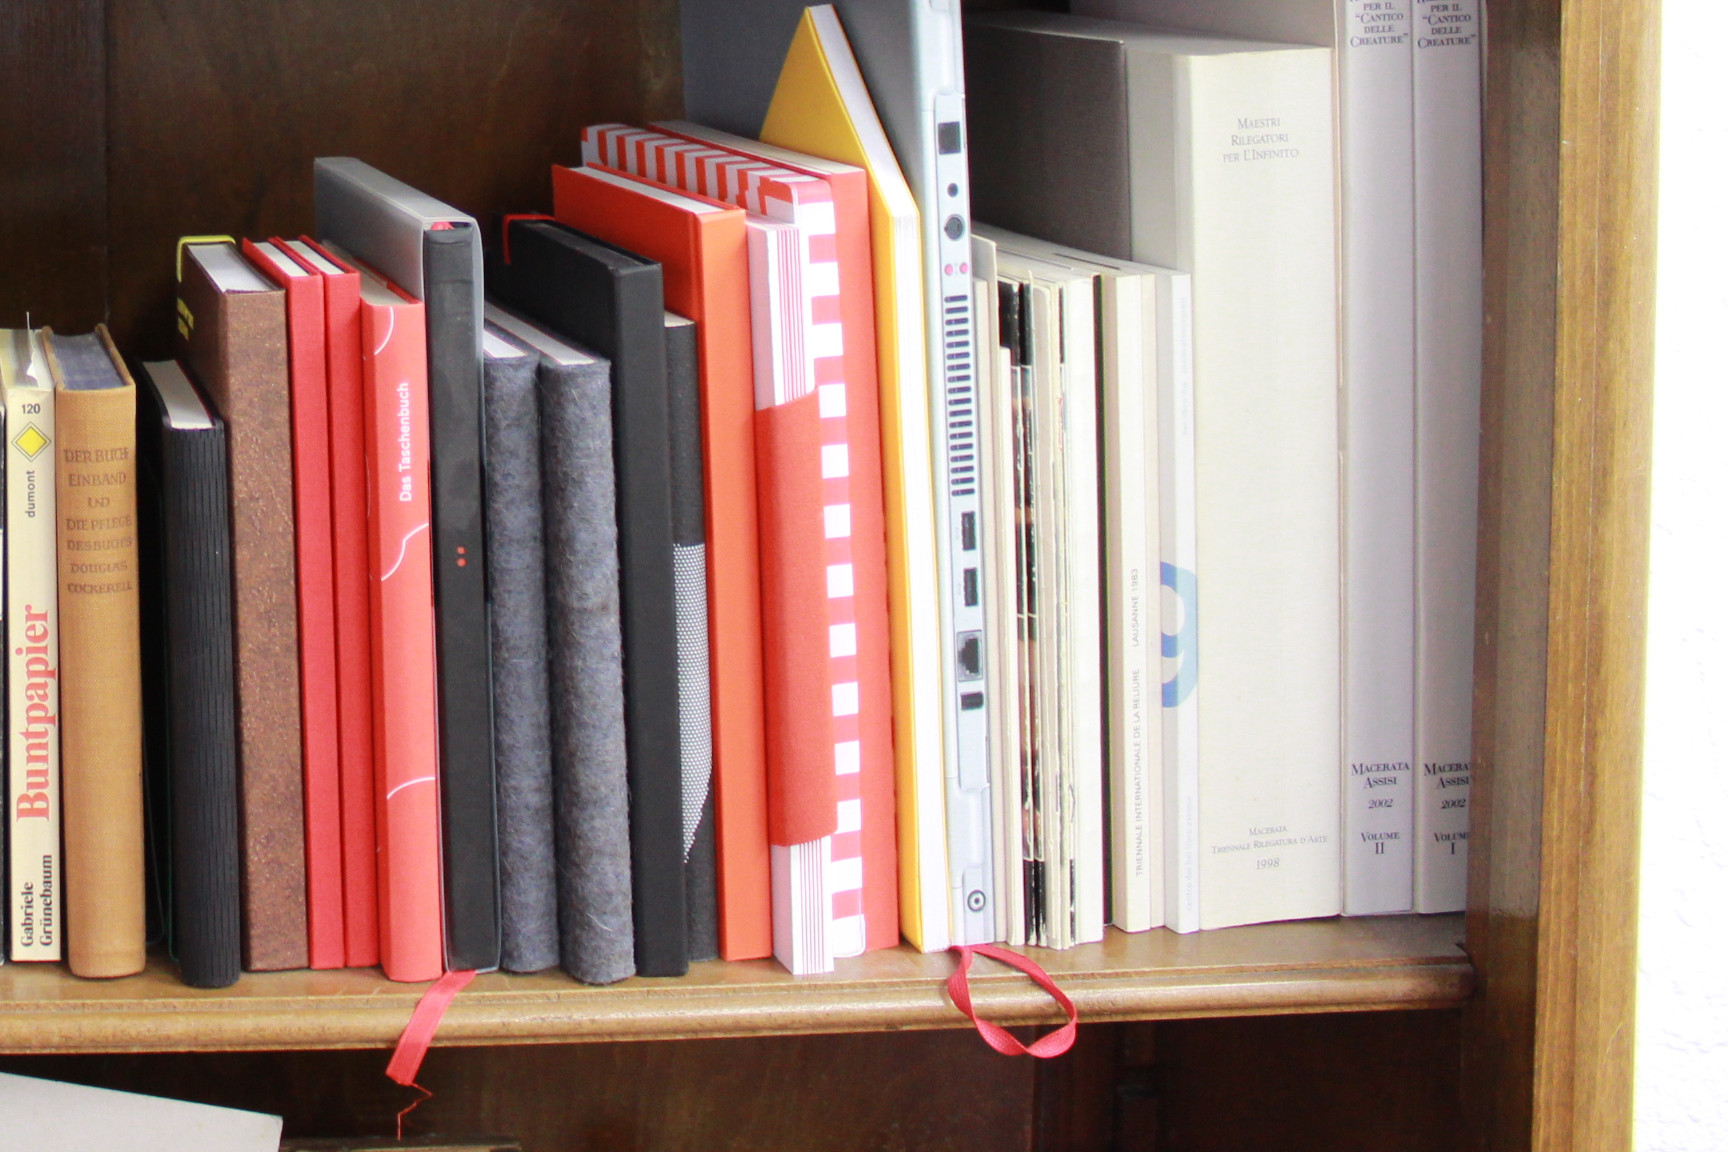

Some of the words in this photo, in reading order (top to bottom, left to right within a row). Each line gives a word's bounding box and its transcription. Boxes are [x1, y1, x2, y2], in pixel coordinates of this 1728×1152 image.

[21, 403, 41, 415] 120
[397, 382, 411, 473] Taschenbuch
[24, 470, 36, 518] dumont
[399, 475, 412, 502] Das
[15, 605, 57, 822] Buntpapier
[1368, 798, 1393, 810] 2002
[1440, 798, 1467, 810] 2002
[1256, 857, 1281, 871] 1998
[20, 881, 35, 948] Gabriele
[39, 854, 53, 948] Grünebaum
